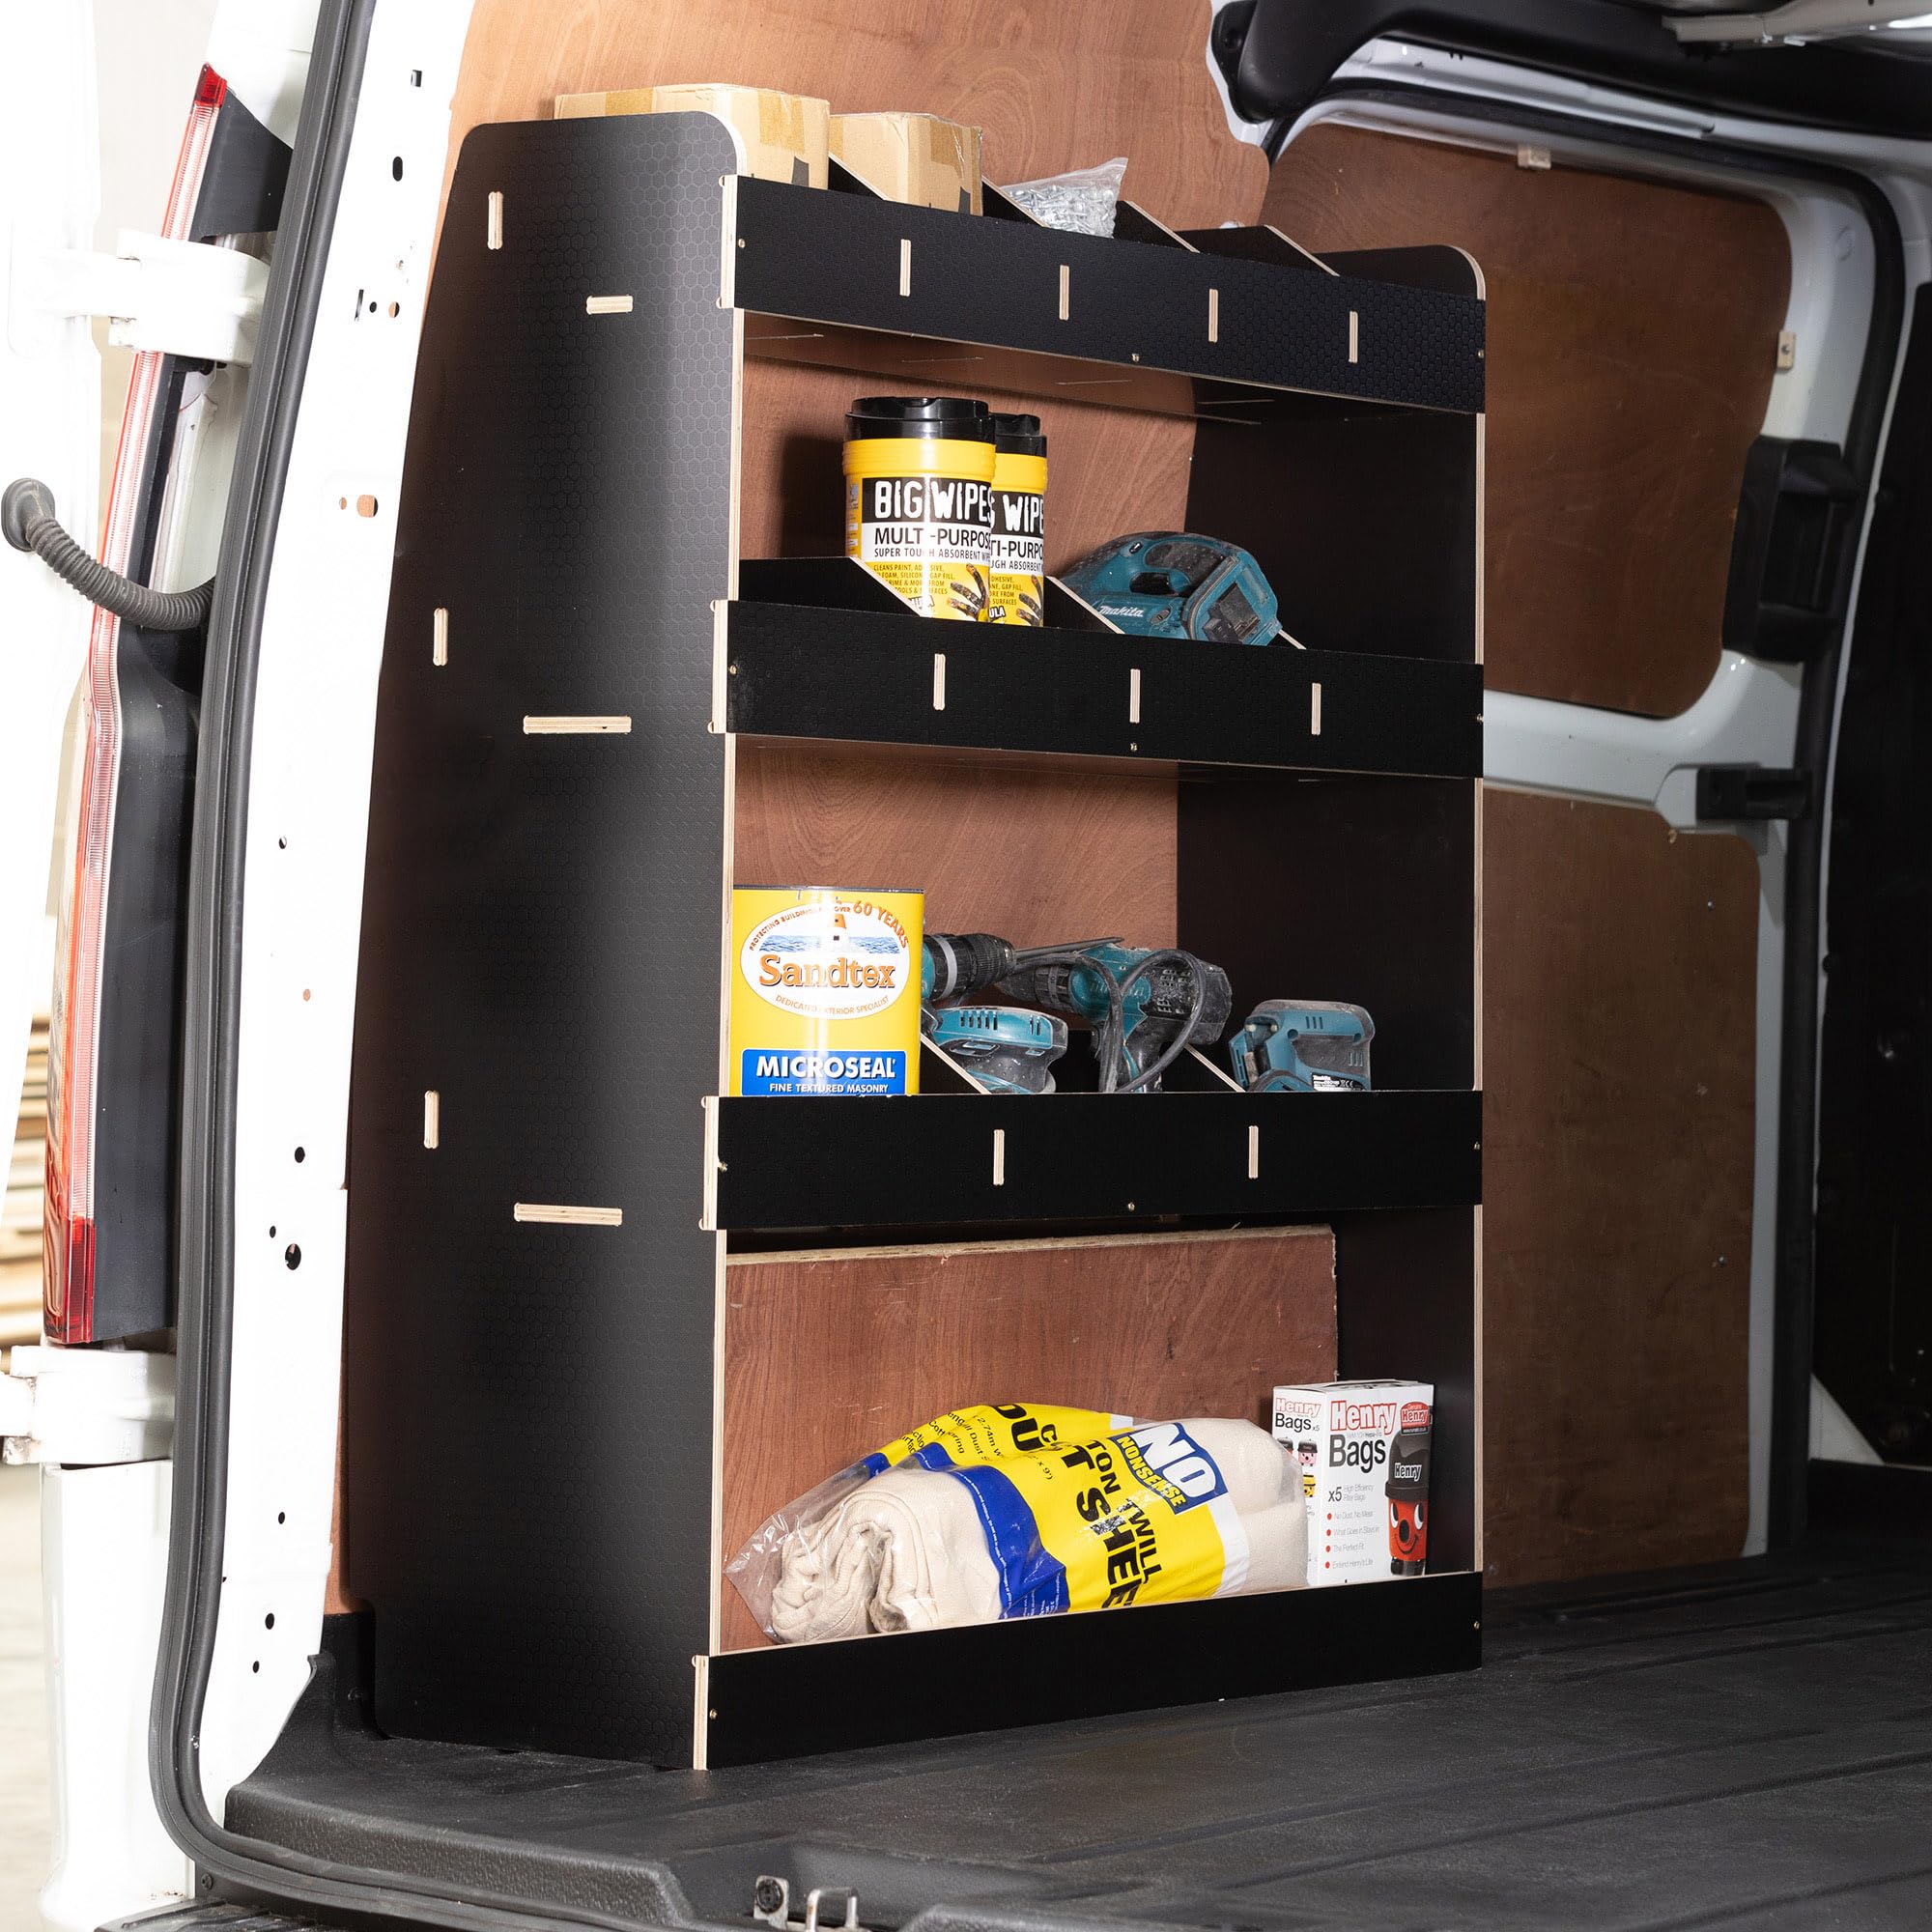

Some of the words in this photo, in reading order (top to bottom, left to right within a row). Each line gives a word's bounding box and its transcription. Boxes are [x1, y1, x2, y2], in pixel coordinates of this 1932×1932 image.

[874, 480, 923, 519] BIG
[874, 548, 901, 557] SUPER
[904, 548, 935, 557] TOUH
[938, 549, 981, 560] ABSORBENT
[749, 919, 781, 952] PROTECTING
[781, 908, 813, 923] BUILDIN
[853, 899, 873, 917] 60
[877, 905, 909, 949] YEARS
[758, 953, 895, 989] Sandtex
[856, 995, 890, 1013] SPECIALIST
[755, 1055, 896, 1079] MICROSEAL
[769, 1082, 793, 1094] FINE
[795, 1083, 844, 1094] TEXTURED
[846, 1083, 890, 1094] MASONRY
[1275, 1397, 1321, 1418] Henry
[1330, 1400, 1397, 1435] Henry
[1401, 1408, 1429, 1425] Henry
[993, 1404, 1095, 1469] DUT
[1275, 1412, 1312, 1433] Bags
[1128, 1423, 1217, 1499] NO
[1329, 1434, 1387, 1475] Bags
[1117, 1435, 1187, 1507] NONSENSE
[1393, 1462, 1423, 1483] Henry
[1040, 1424, 1122, 1494] CTON
[1116, 1498, 1163, 1584] TWILL
[1328, 1486, 1343, 1503] x5
